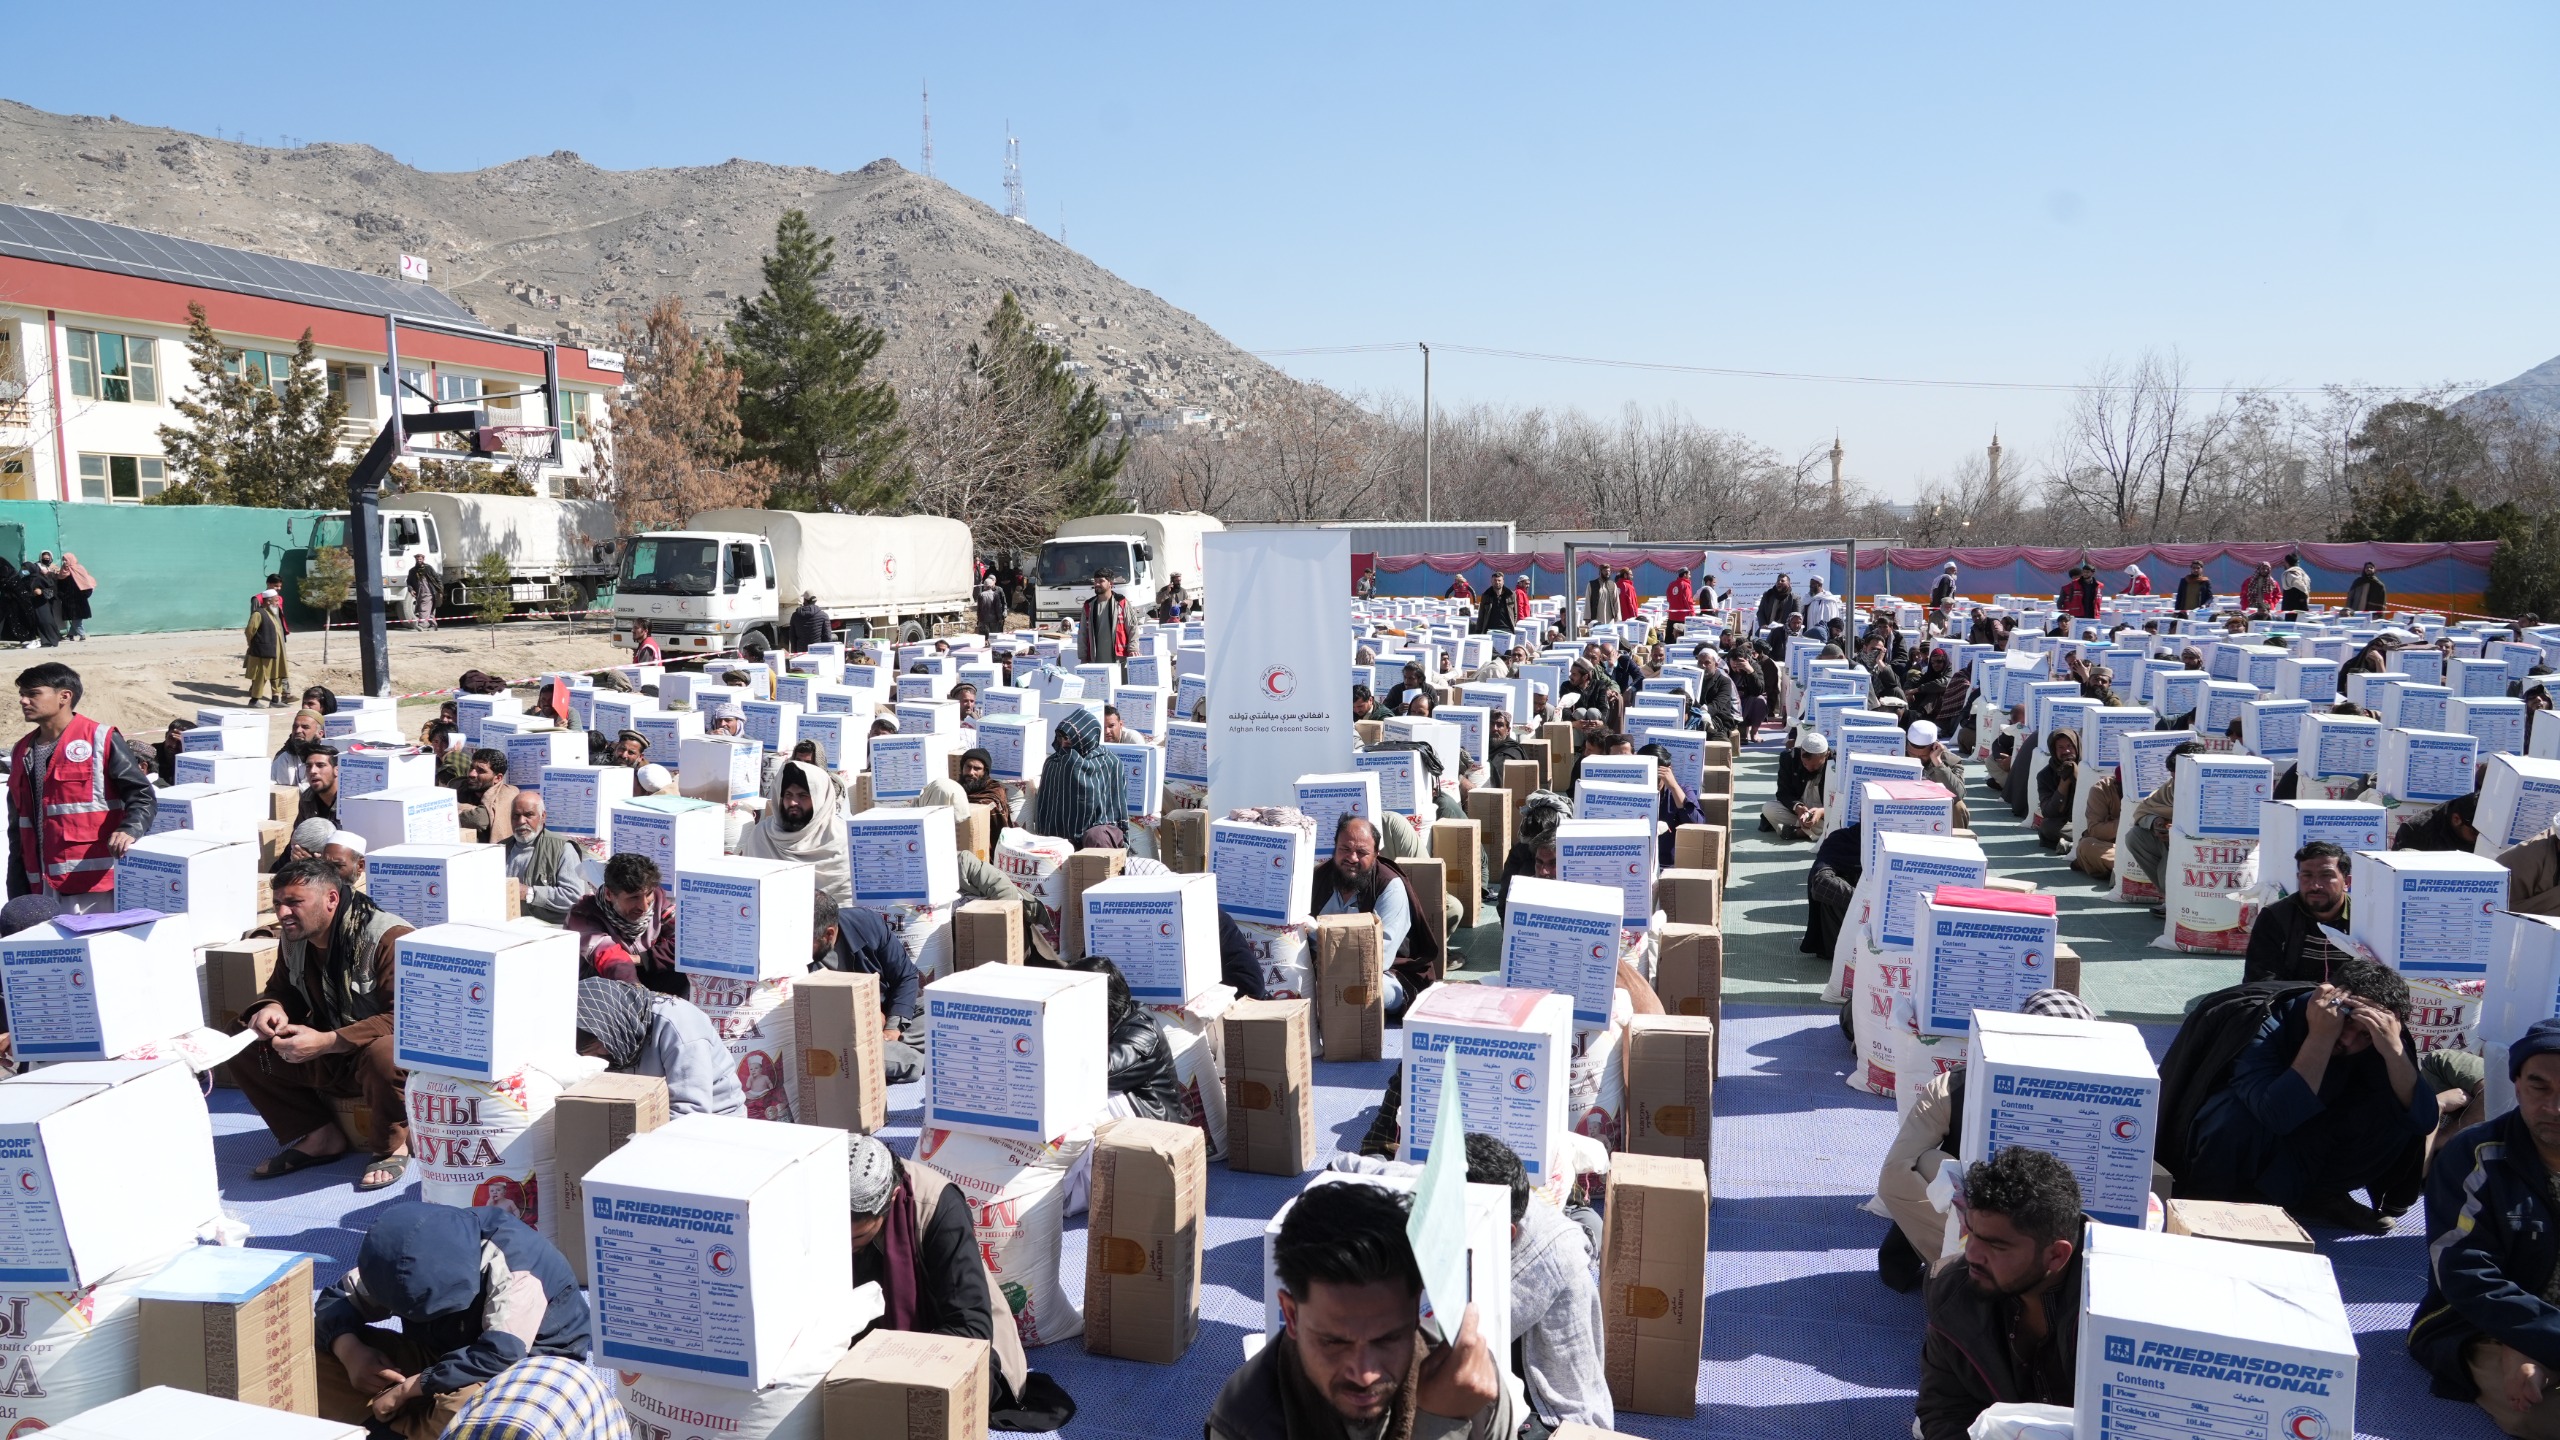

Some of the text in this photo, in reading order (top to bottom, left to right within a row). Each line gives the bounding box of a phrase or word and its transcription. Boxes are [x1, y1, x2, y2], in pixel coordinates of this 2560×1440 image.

[1861, 771, 1915, 780] INTERNATIONAL
[1863, 767, 1918, 775] FRIEDENSDORF
[1595, 799, 1651, 809] INTERNATIONAL
[1597, 794, 1653, 802] FRIEDENSDORF
[622, 821, 670, 830] INTERNATIONAL
[623, 816, 672, 825] FRIEDENSDORF
[861, 829, 918, 837] INTERNATIONAL
[1228, 832, 1288, 844] FRIEDENSDORF
[1226, 838, 1287, 850] INTERNATIONAL
[127, 862, 182, 875] INTERNATIONAL
[128, 856, 184, 869] FRIEDENSDORF
[381, 863, 442, 871] FRIEDENSDORF
[1905, 860, 1979, 873] FRIEDENSDORF
[379, 869, 441, 877] INTERNATIONAL
[1903, 866, 1977, 880] INTERNATIONAL
[2183, 868, 2256, 889] МУКА
[693, 880, 753, 891] FRIEDENSDORF
[2420, 879, 2500, 887] FRIEDENSDORF
[691, 887, 753, 898] INTERNATIONAL
[2416, 886, 2499, 894] INTERNATIONAL
[1530, 913, 1612, 929] FRIEDENSDORF
[1517, 930, 1540, 938] Contents
[1527, 920, 1610, 937] INTERNATIONAL
[1955, 922, 2045, 934] FRIEDENSDORF
[1951, 930, 2044, 943] INTERNATIONAL
[1942, 940, 1966, 948] Contents
[16, 948, 82, 957] FRIEDENSDORF
[16, 956, 83, 965] INTERNATIONAL
[415, 952, 488, 968] FRIEDENSDORF
[413, 960, 486, 976] INTERNATIONAL
[947, 1002, 1033, 1017] FRIEDENSDORF
[2409, 1005, 2465, 1026] НЫ
[945, 1012, 1032, 1027] INTERNATIONAL
[937, 1022, 959, 1031] Contents
[1432, 1033, 1538, 1052] FRIEDENSDORF
[1872, 1040, 1882, 1051] 50
[1430, 1043, 1535, 1061] INTERNATIONAL
[427, 1081, 457, 1093] БИДАЙ
[2018, 1077, 2146, 1098] FRIEDENSDORF
[2015, 1087, 2142, 1107] INTERNATIONAL
[2001, 1100, 2034, 1110] Contents
[446, 1128, 505, 1137] первый сорт
[1009, 1155, 1020, 1167] kg
[615, 1199, 735, 1223] FRIEDENSDORF
[613, 1211, 734, 1235] INTERNATIONAL
[603, 1226, 633, 1237] Contents
[605, 1253, 624, 1261] Cooking
[609, 1317, 629, 1325] Children
[610, 1329, 632, 1337] Macaroni
[23, 1344, 54, 1355] сорт
[2116, 1371, 2165, 1390] Contents
[2136, 1355, 2331, 1397] INTERNATIONAL
[2116, 1389, 2209, 1412] Flour 50kg
[630, 1388, 740, 1432] пшеничная
[2116, 1405, 2213, 1429] Cooking Oil 10Liter
[2115, 1420, 2137, 1432] Sugar
